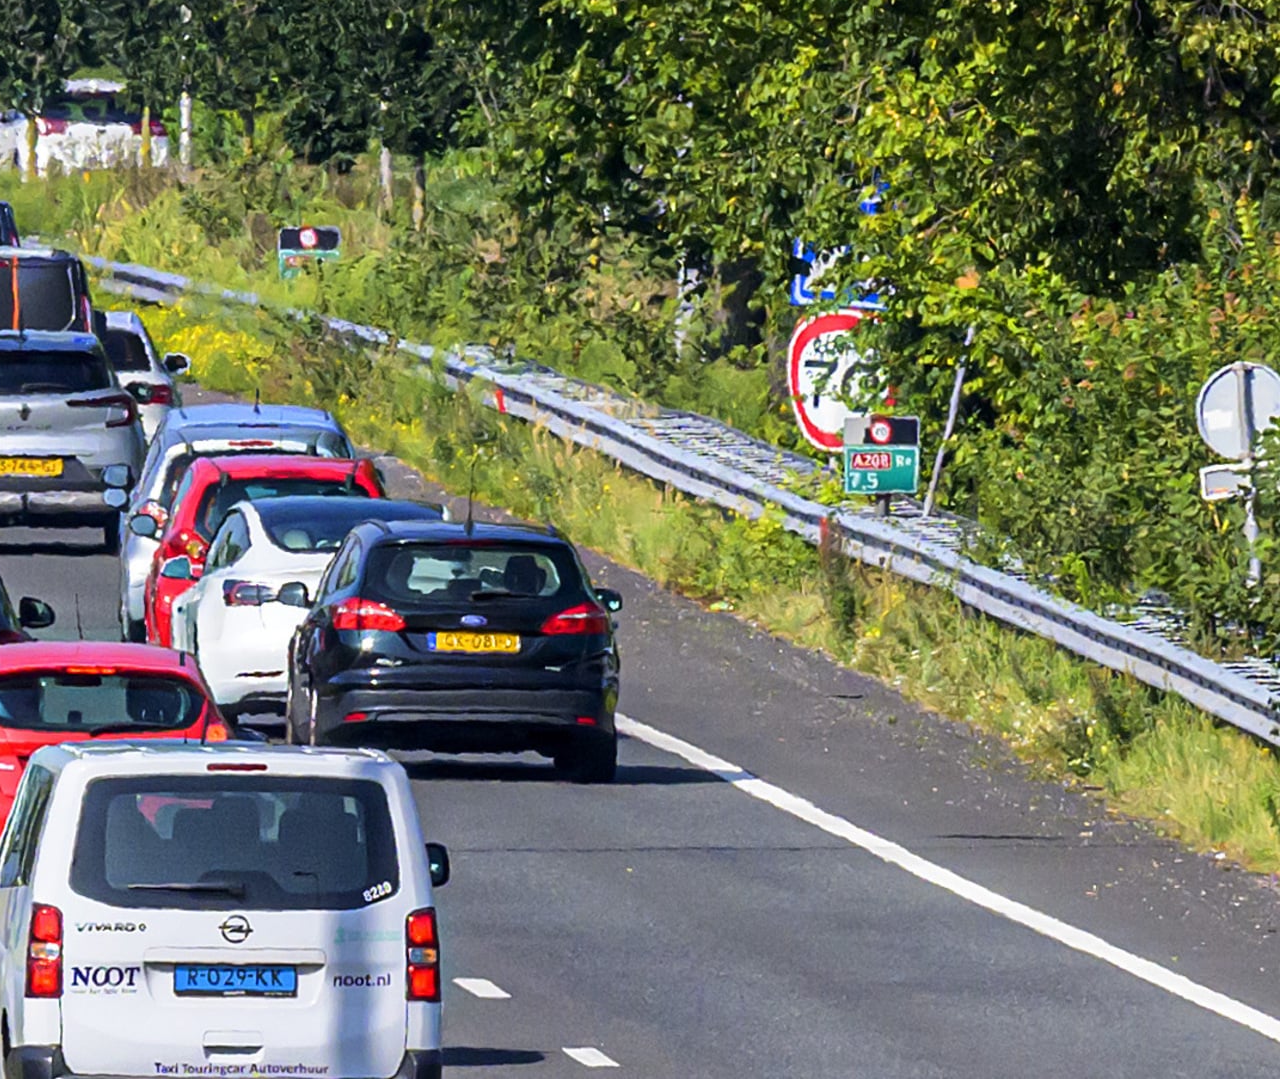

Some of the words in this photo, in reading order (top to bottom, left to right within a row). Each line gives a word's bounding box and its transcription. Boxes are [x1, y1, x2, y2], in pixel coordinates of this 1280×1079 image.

[70, 966, 141, 987] NOOT
[186, 967, 283, 987] R-029-KK
[332, 972, 392, 988] noot.nl
[154, 1062, 179, 1074] Taxi
[183, 1062, 245, 1076] Touringcar
[249, 1062, 329, 1074] Autoverhuur
